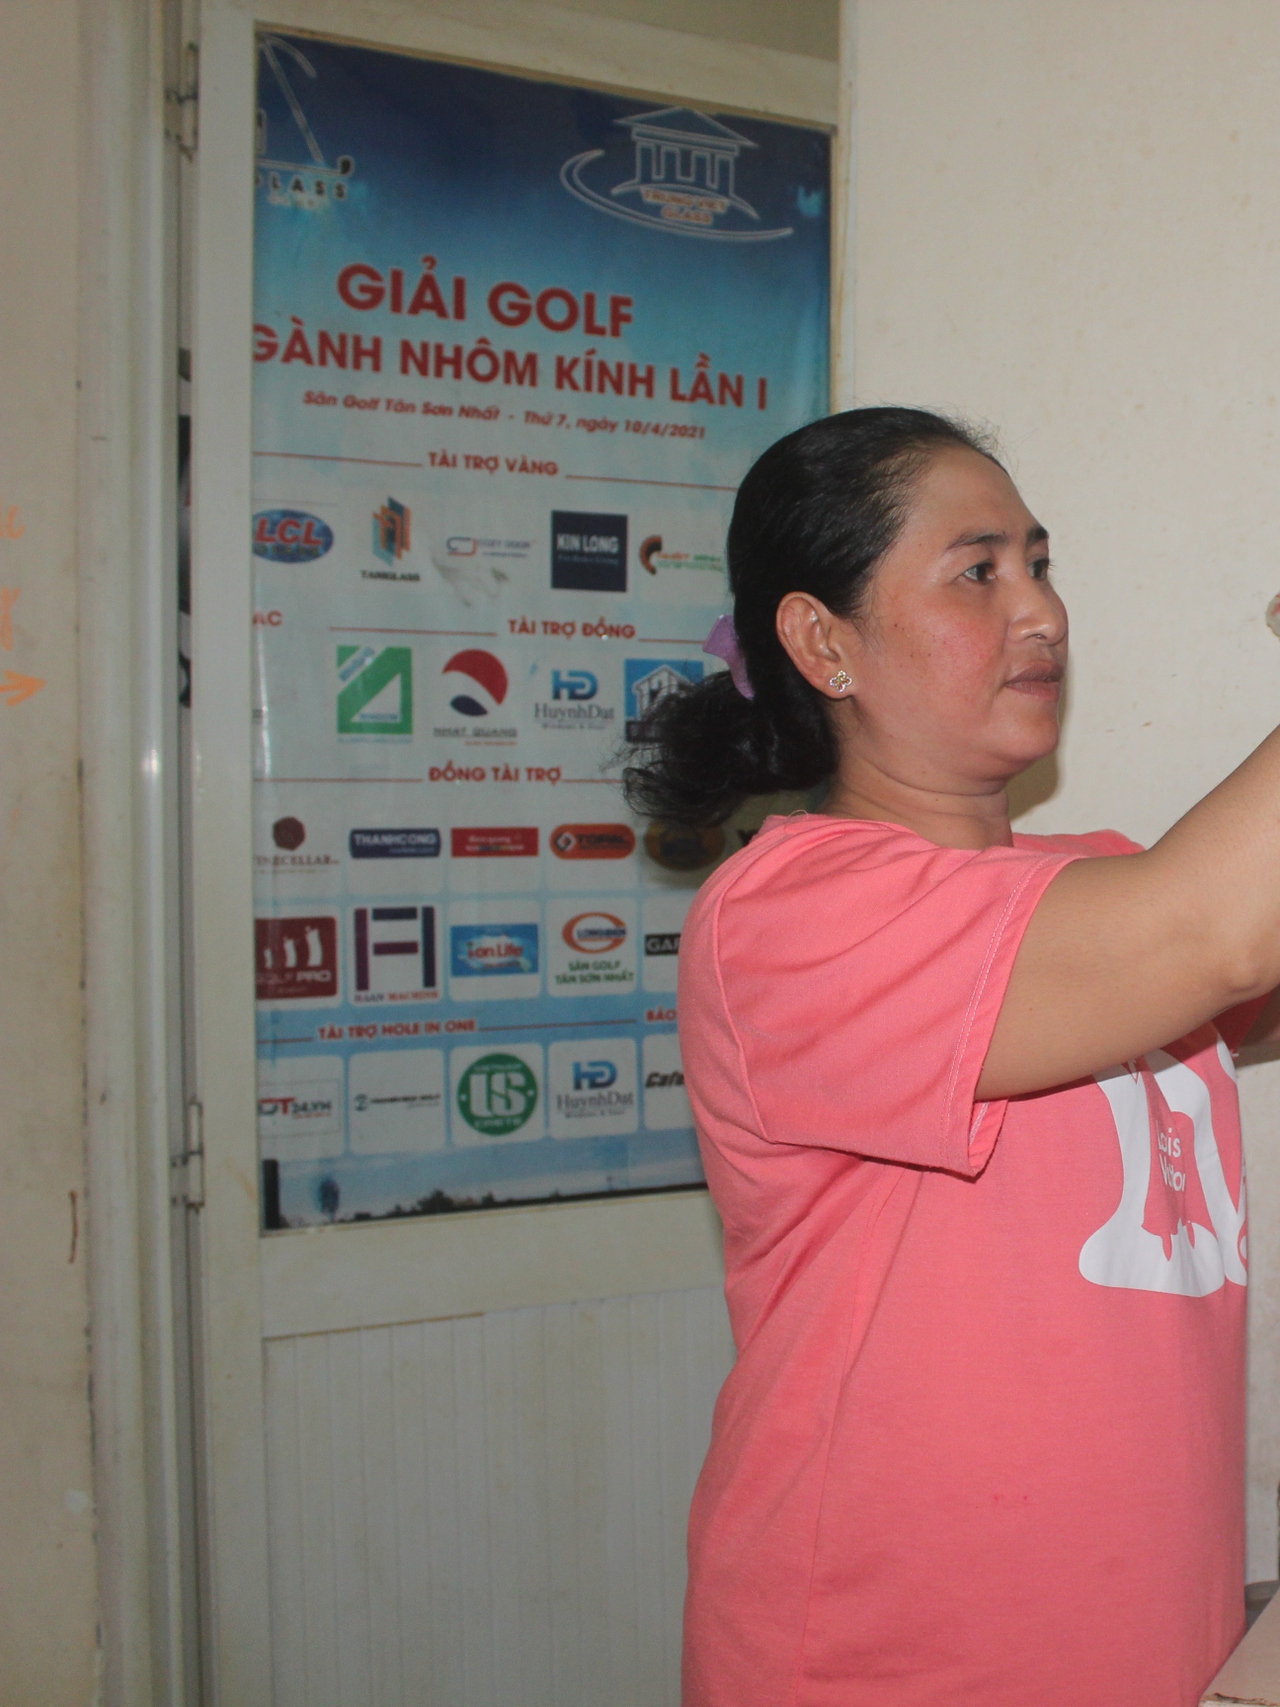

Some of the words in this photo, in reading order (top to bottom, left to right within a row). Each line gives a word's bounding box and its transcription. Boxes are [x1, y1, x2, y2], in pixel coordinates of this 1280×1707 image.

[254, 171, 347, 199] LASS
[336, 254, 467, 322] GIẢI
[486, 280, 634, 338] GOLF
[252, 314, 383, 374] GÀNH
[400, 336, 538, 388] NHÔM
[554, 347, 655, 400] KÍNH
[669, 351, 744, 409] LẦN
[757, 376, 768, 411] I
[343, 393, 380, 411] Golf
[576, 415, 619, 433] ngày
[624, 418, 707, 439] 10/4/2021
[428, 448, 458, 469] TÀI
[463, 453, 499, 475] TRỢ
[505, 453, 559, 476] VÀNG
[254, 517, 323, 546] LCL
[556, 533, 581, 551] KIN
[582, 534, 620, 553] LONG
[508, 615, 536, 635] TÀI
[542, 619, 577, 640] TRỢ
[582, 615, 636, 639] ĐỒNG
[428, 758, 487, 782] ĐỒNG
[491, 761, 520, 782] TÀI
[525, 762, 562, 783] TRỢ
[318, 1022, 344, 1041] TÀI
[348, 1023, 378, 1041] TRỢ
[381, 1021, 421, 1037] HOLE
[424, 1020, 441, 1034] IN
[444, 1018, 477, 1033] ONE
